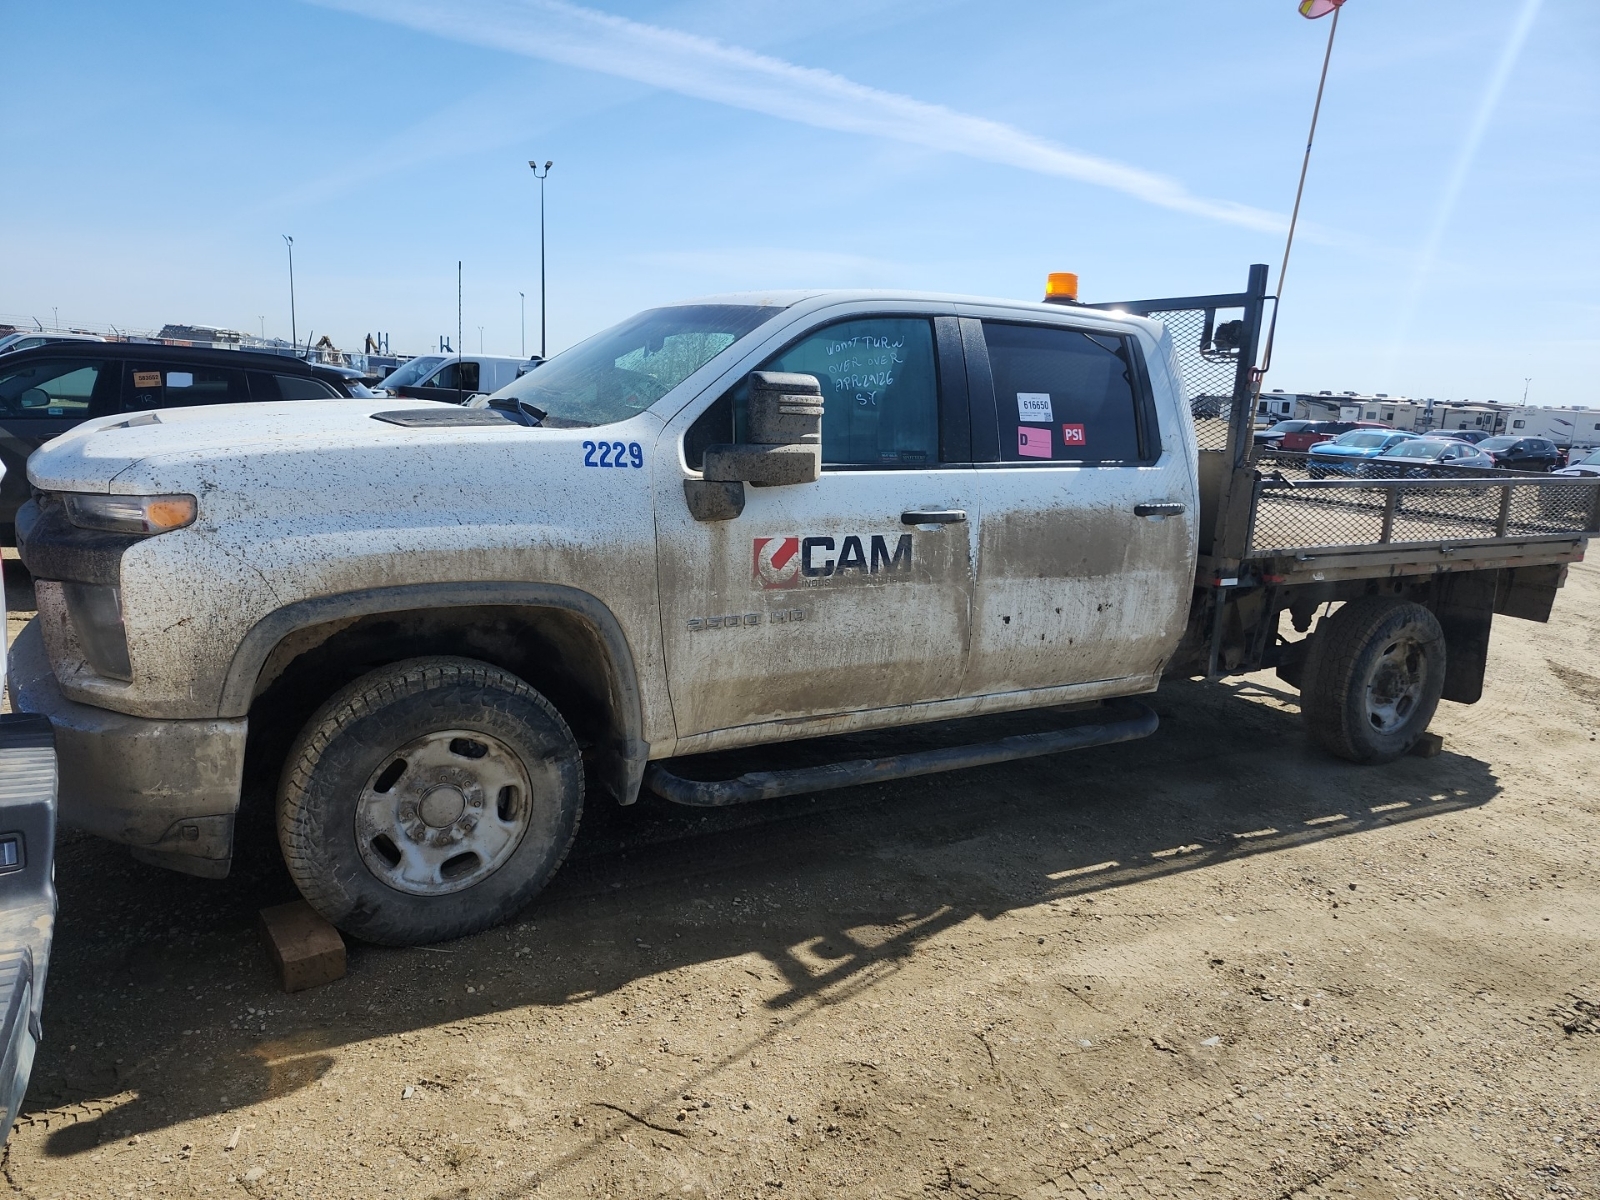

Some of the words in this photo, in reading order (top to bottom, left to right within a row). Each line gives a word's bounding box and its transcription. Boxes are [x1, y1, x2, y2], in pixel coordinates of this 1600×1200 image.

[829, 357, 861, 373] OVER
[868, 353, 903, 365] OVER
[1023, 401, 1049, 410] 616650
[1020, 433, 1028, 446] D
[1065, 429, 1083, 441] PSI
[583, 441, 643, 468] 2229
[802, 534, 912, 577] CAM
[687, 613, 761, 632] 2500
[770, 609, 804, 624] HD
